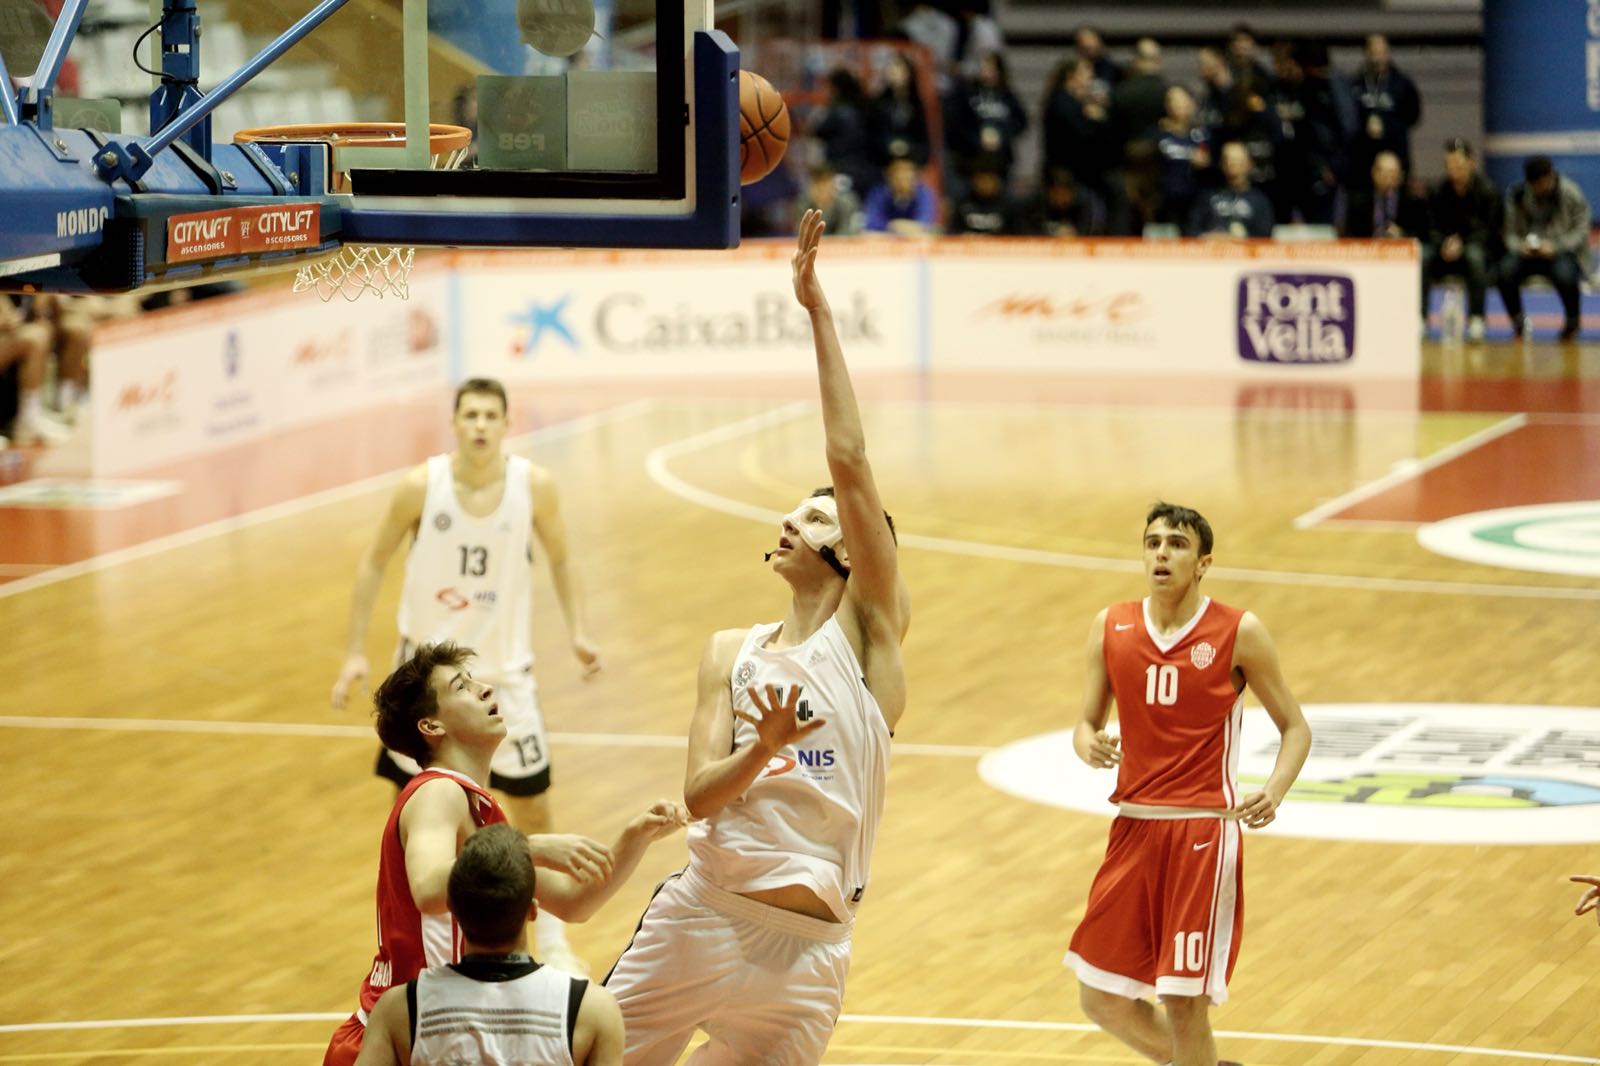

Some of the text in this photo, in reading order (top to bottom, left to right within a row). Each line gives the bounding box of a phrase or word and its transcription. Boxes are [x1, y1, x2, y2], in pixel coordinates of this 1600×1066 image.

[173, 216, 232, 244] CITYLIFT
[258, 209, 314, 234] CITYLIFT
[1246, 275, 1345, 319] Font
[1244, 315, 1347, 360] Vella
[458, 545, 488, 576] 13
[1145, 663, 1179, 706] 10
[510, 734, 543, 767] 13
[798, 749, 834, 767] NIS
[1173, 931, 1204, 972] 10
